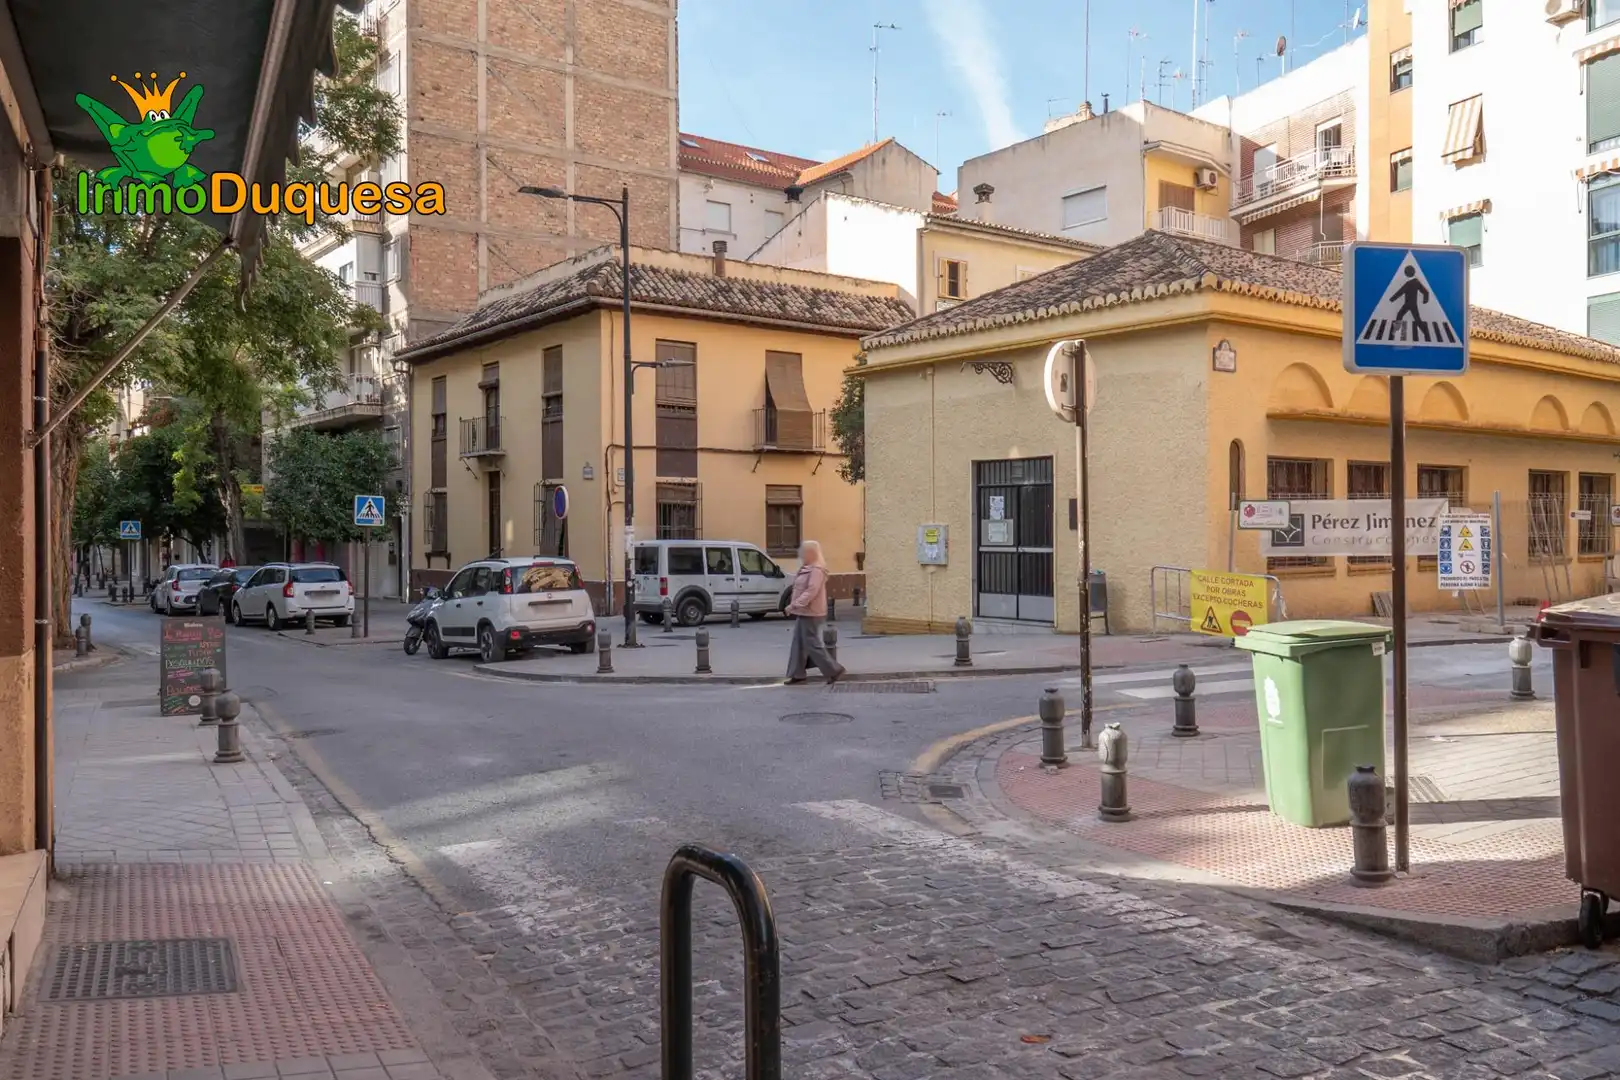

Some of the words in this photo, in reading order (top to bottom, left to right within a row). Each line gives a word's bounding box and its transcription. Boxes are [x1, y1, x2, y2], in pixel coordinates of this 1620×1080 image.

[1311, 513, 1360, 530] Pérez
[1365, 513, 1437, 531] Jimnez
[1311, 534, 1437, 546] Construccones
[1197, 575, 1219, 584] CALLE
[1221, 577, 1254, 588] CORTADA
[1206, 585, 1220, 593] POR
[1222, 588, 1246, 597] OBRAS
[1193, 593, 1222, 604] EXCEPTO
[1223, 598, 1264, 609] COCHERAS
